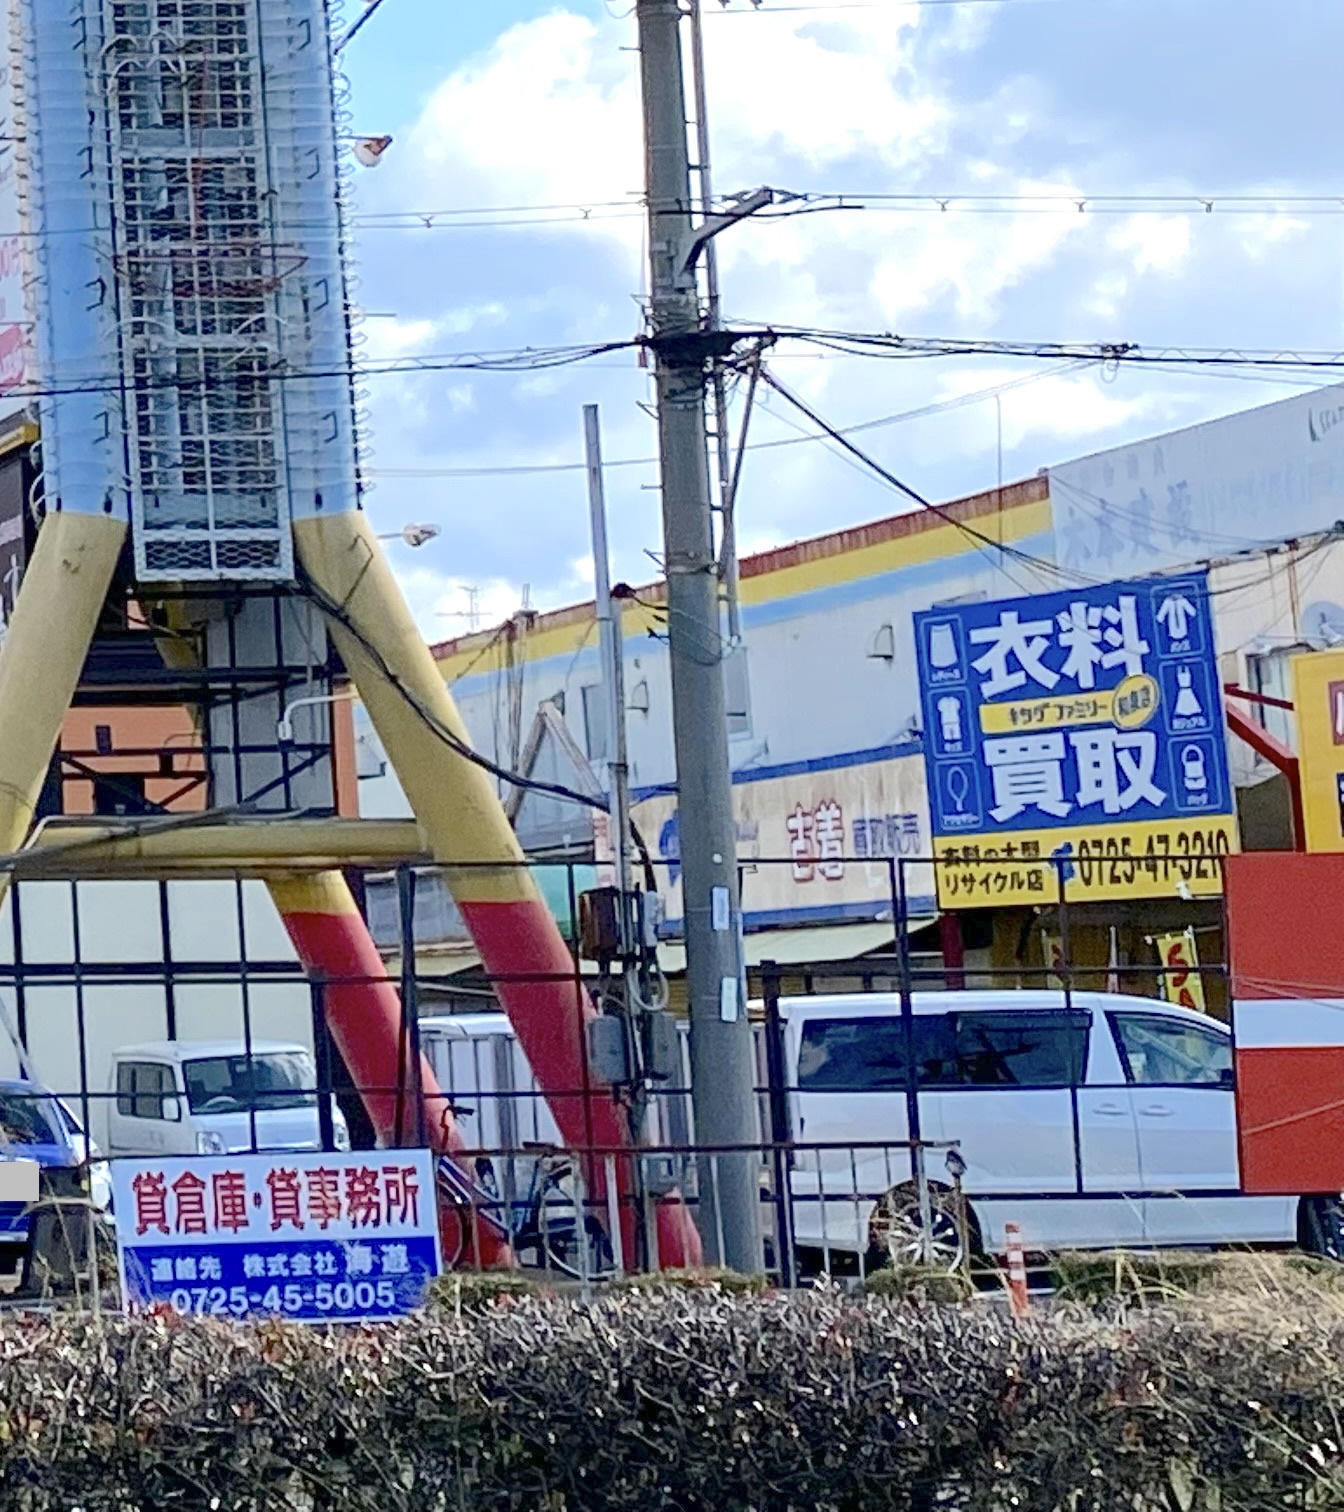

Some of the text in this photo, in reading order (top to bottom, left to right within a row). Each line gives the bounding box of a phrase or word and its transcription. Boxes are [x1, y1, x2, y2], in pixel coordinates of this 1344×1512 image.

[969, 595, 1150, 700] 衣料
[983, 731, 1167, 824] 買取
[785, 796, 846, 885] 古着
[945, 870, 1044, 896] リサイクル店
[131, 1165, 421, 1236] 貸倉庫・貸事務所
[150, 1254, 224, 1282] 連絡先
[243, 1251, 338, 1278] 株式会社
[170, 1281, 397, 1314] 0725-45-5005
